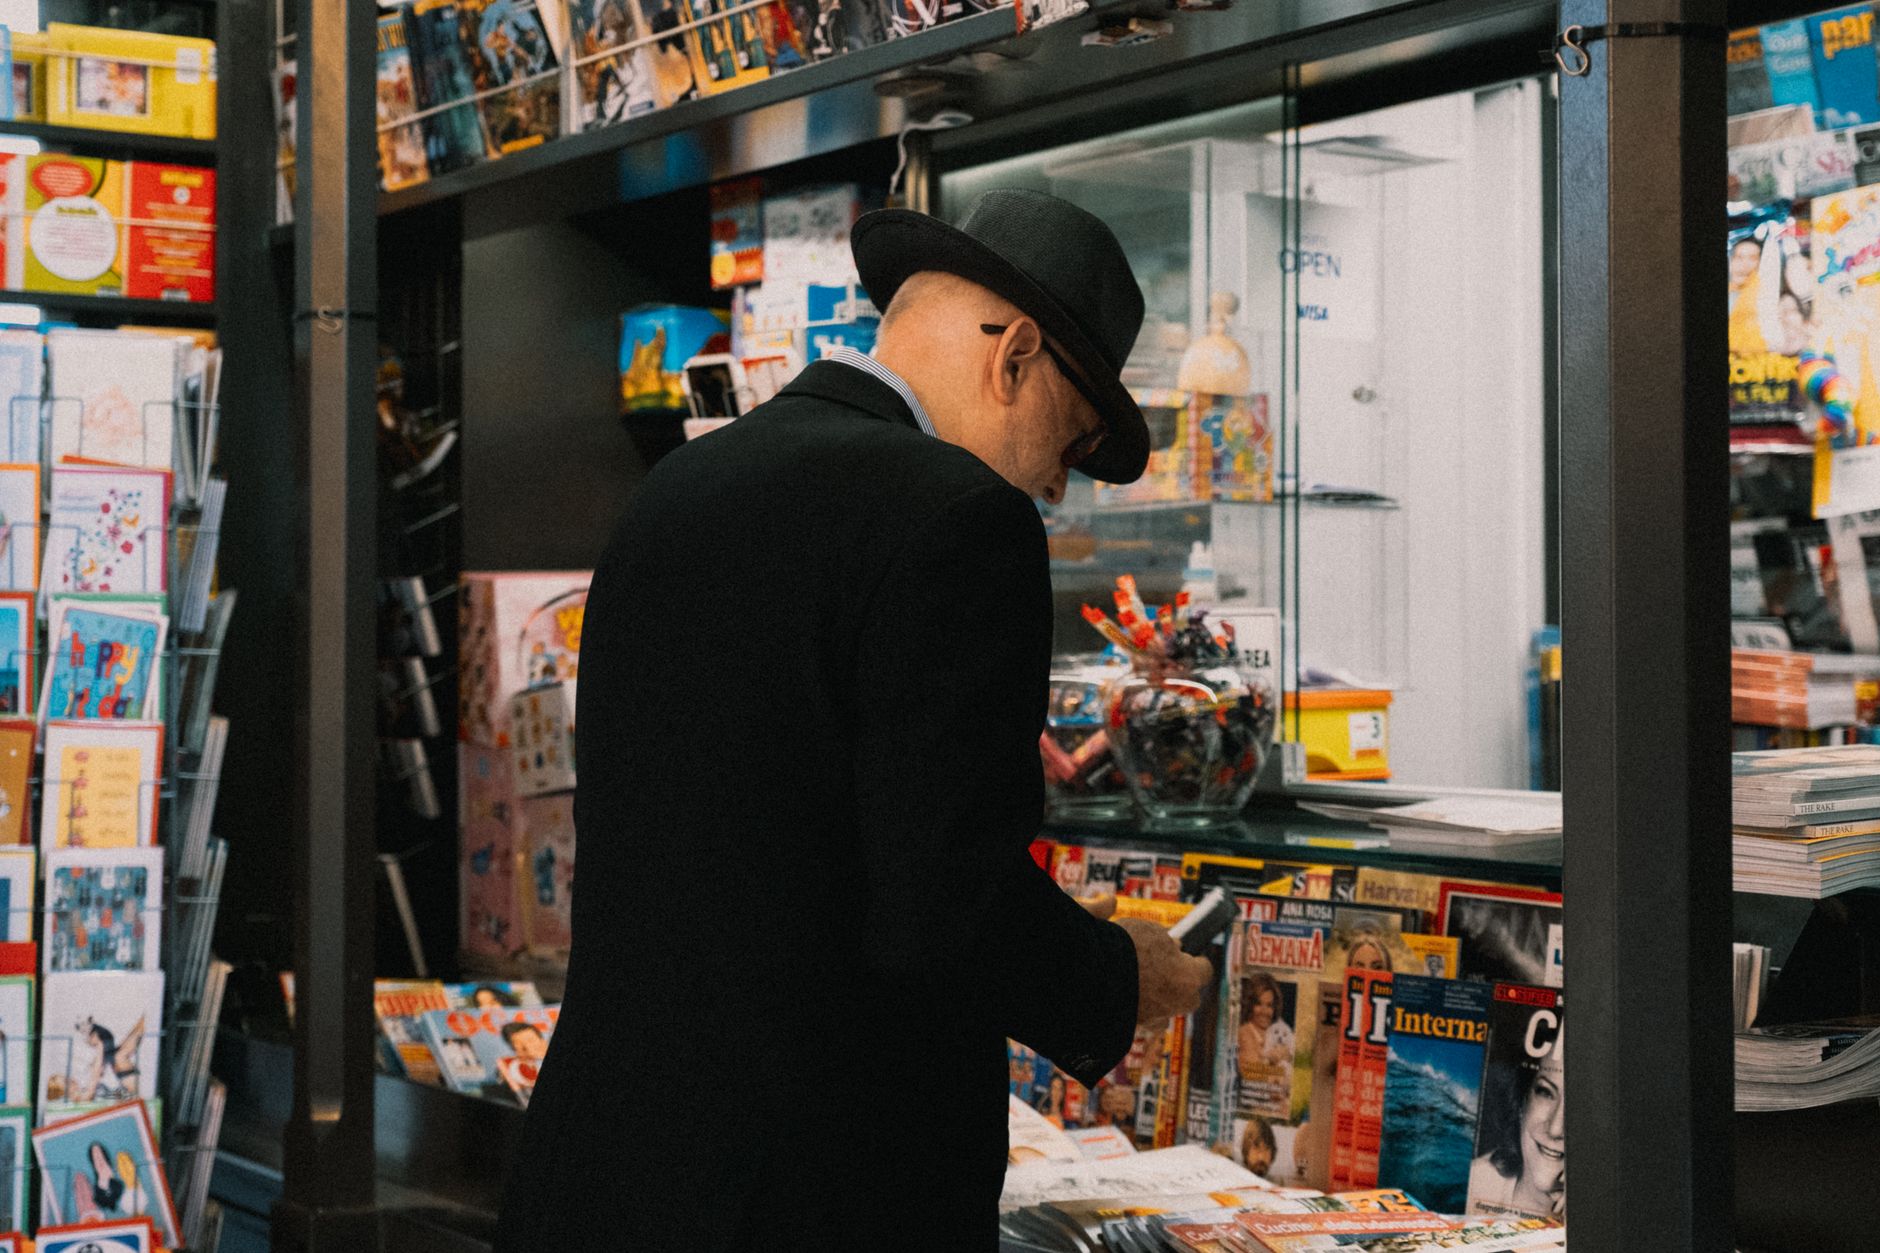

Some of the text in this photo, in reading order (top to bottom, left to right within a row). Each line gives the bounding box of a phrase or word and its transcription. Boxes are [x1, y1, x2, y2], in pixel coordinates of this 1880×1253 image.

[1278, 249, 1342, 278] OPEN
[1297, 302, 1329, 321] VISA
[1800, 803, 1836, 814] THE RAKE
[1821, 825, 1854, 836] THE RAKE
[1282, 901, 1333, 920] ANA ROSA
[1247, 923, 1324, 971] SEMANA
[1394, 1007, 1488, 1042] Interna
